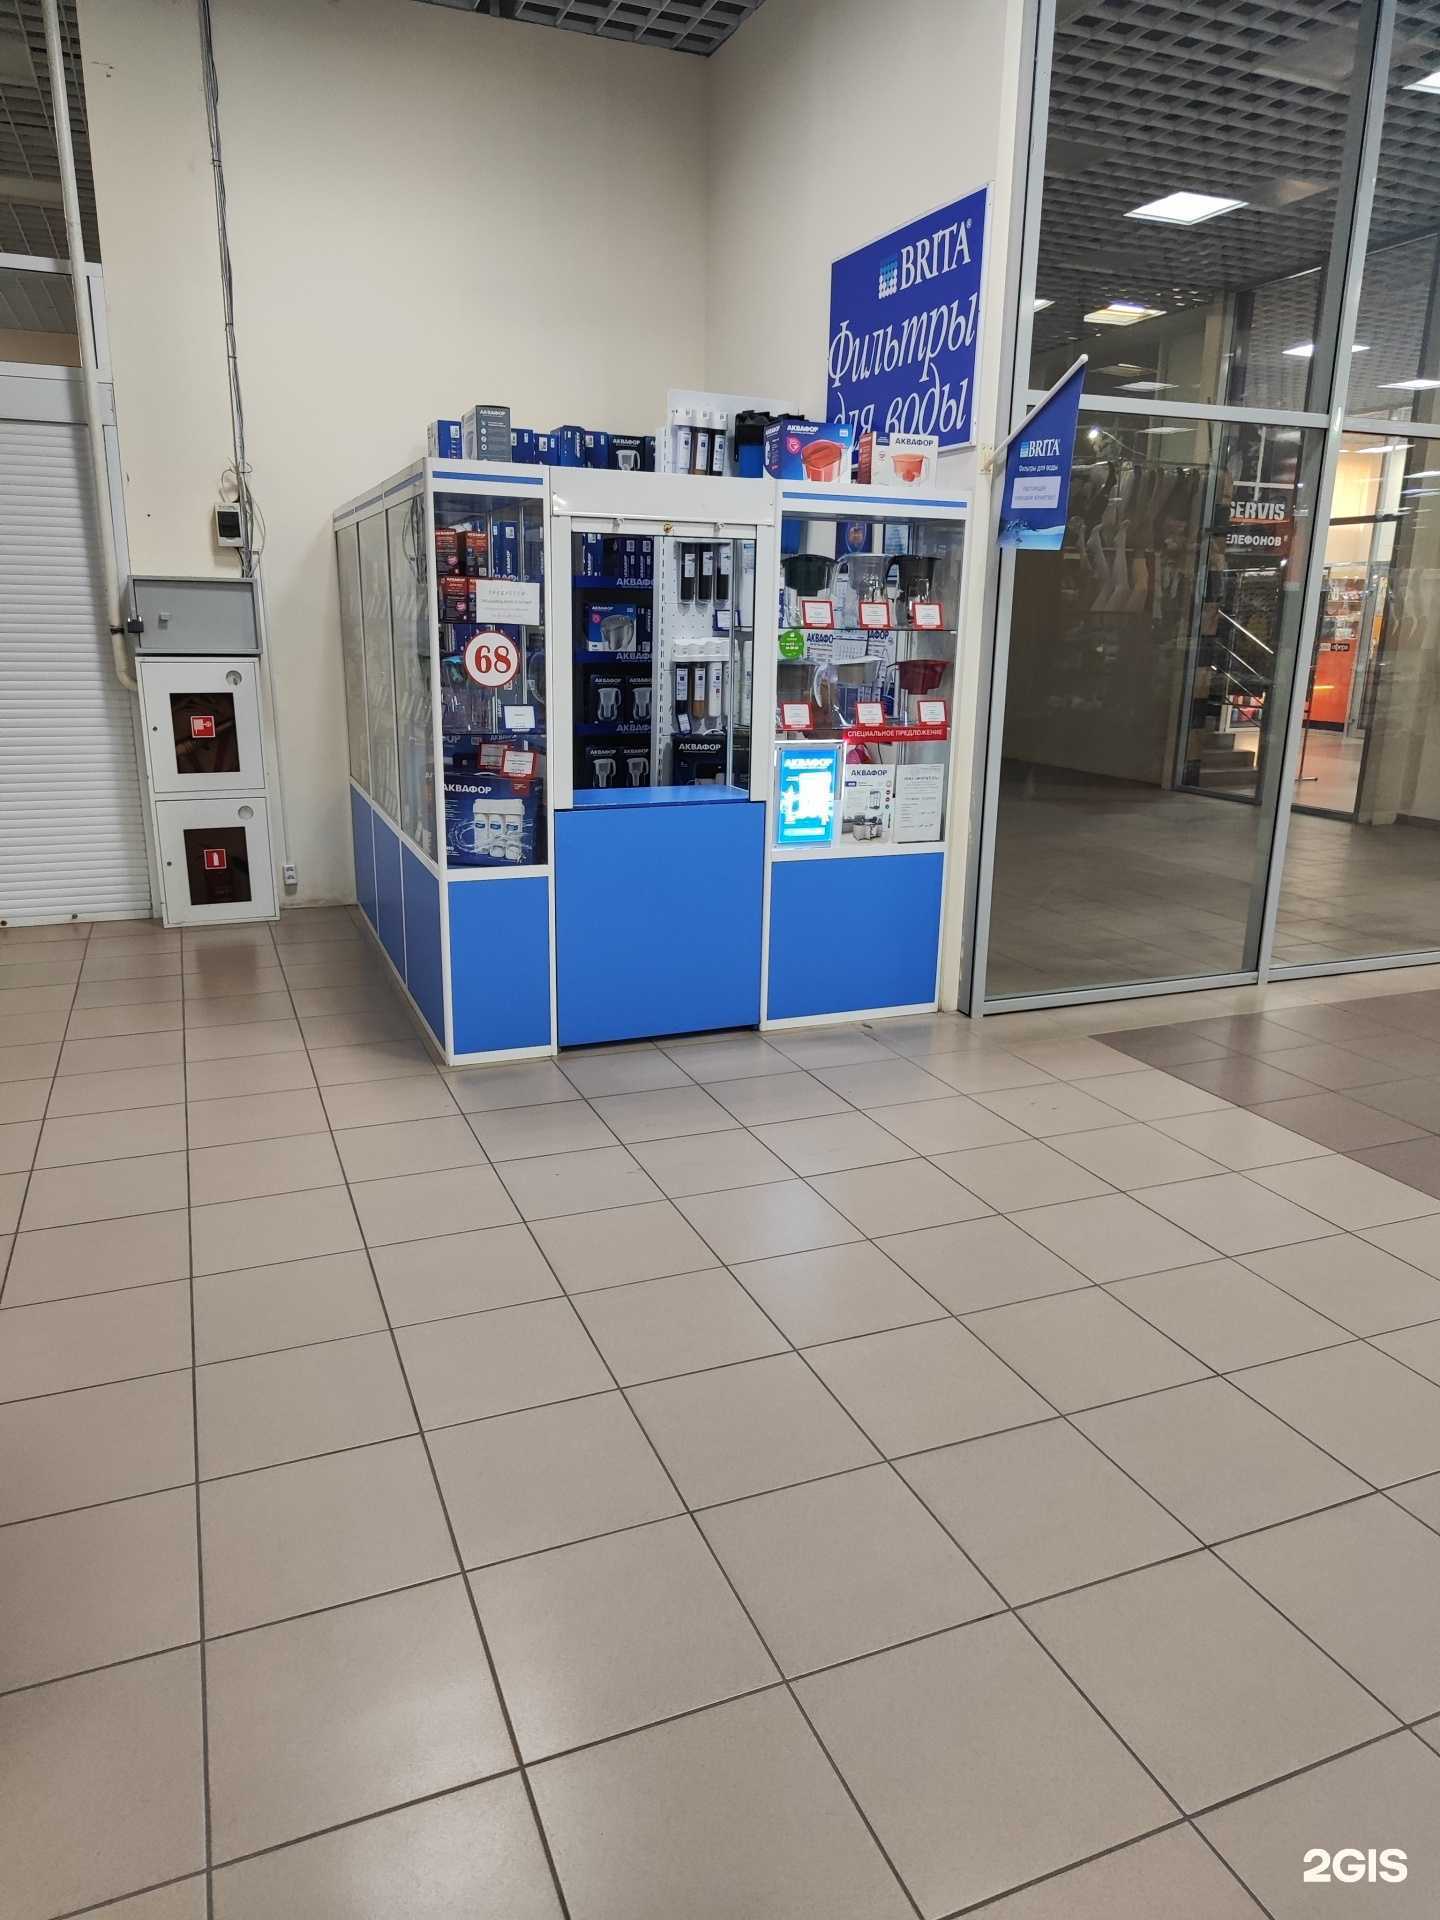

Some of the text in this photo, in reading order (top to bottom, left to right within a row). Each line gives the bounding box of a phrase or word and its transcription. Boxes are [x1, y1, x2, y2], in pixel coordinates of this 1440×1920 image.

[828, 292, 978, 388] Фильтры
[885, 362, 969, 435] воды
[895, 437, 934, 447] АКВАФОР
[1029, 438, 1061, 457] BRITA
[1225, 534, 1282, 547] ЕЛЕФОНОВ
[807, 632, 833, 644] АКВАФО
[474, 645, 512, 674] 68
[847, 728, 943, 738] СПЕЦИАЛЬНОЕ ПРЕДЛОЖЕНИЕ
[678, 743, 721, 752] АКВАФОР
[851, 769, 888, 777] АКВАФОР
[442, 783, 492, 795] АКВАФОР
